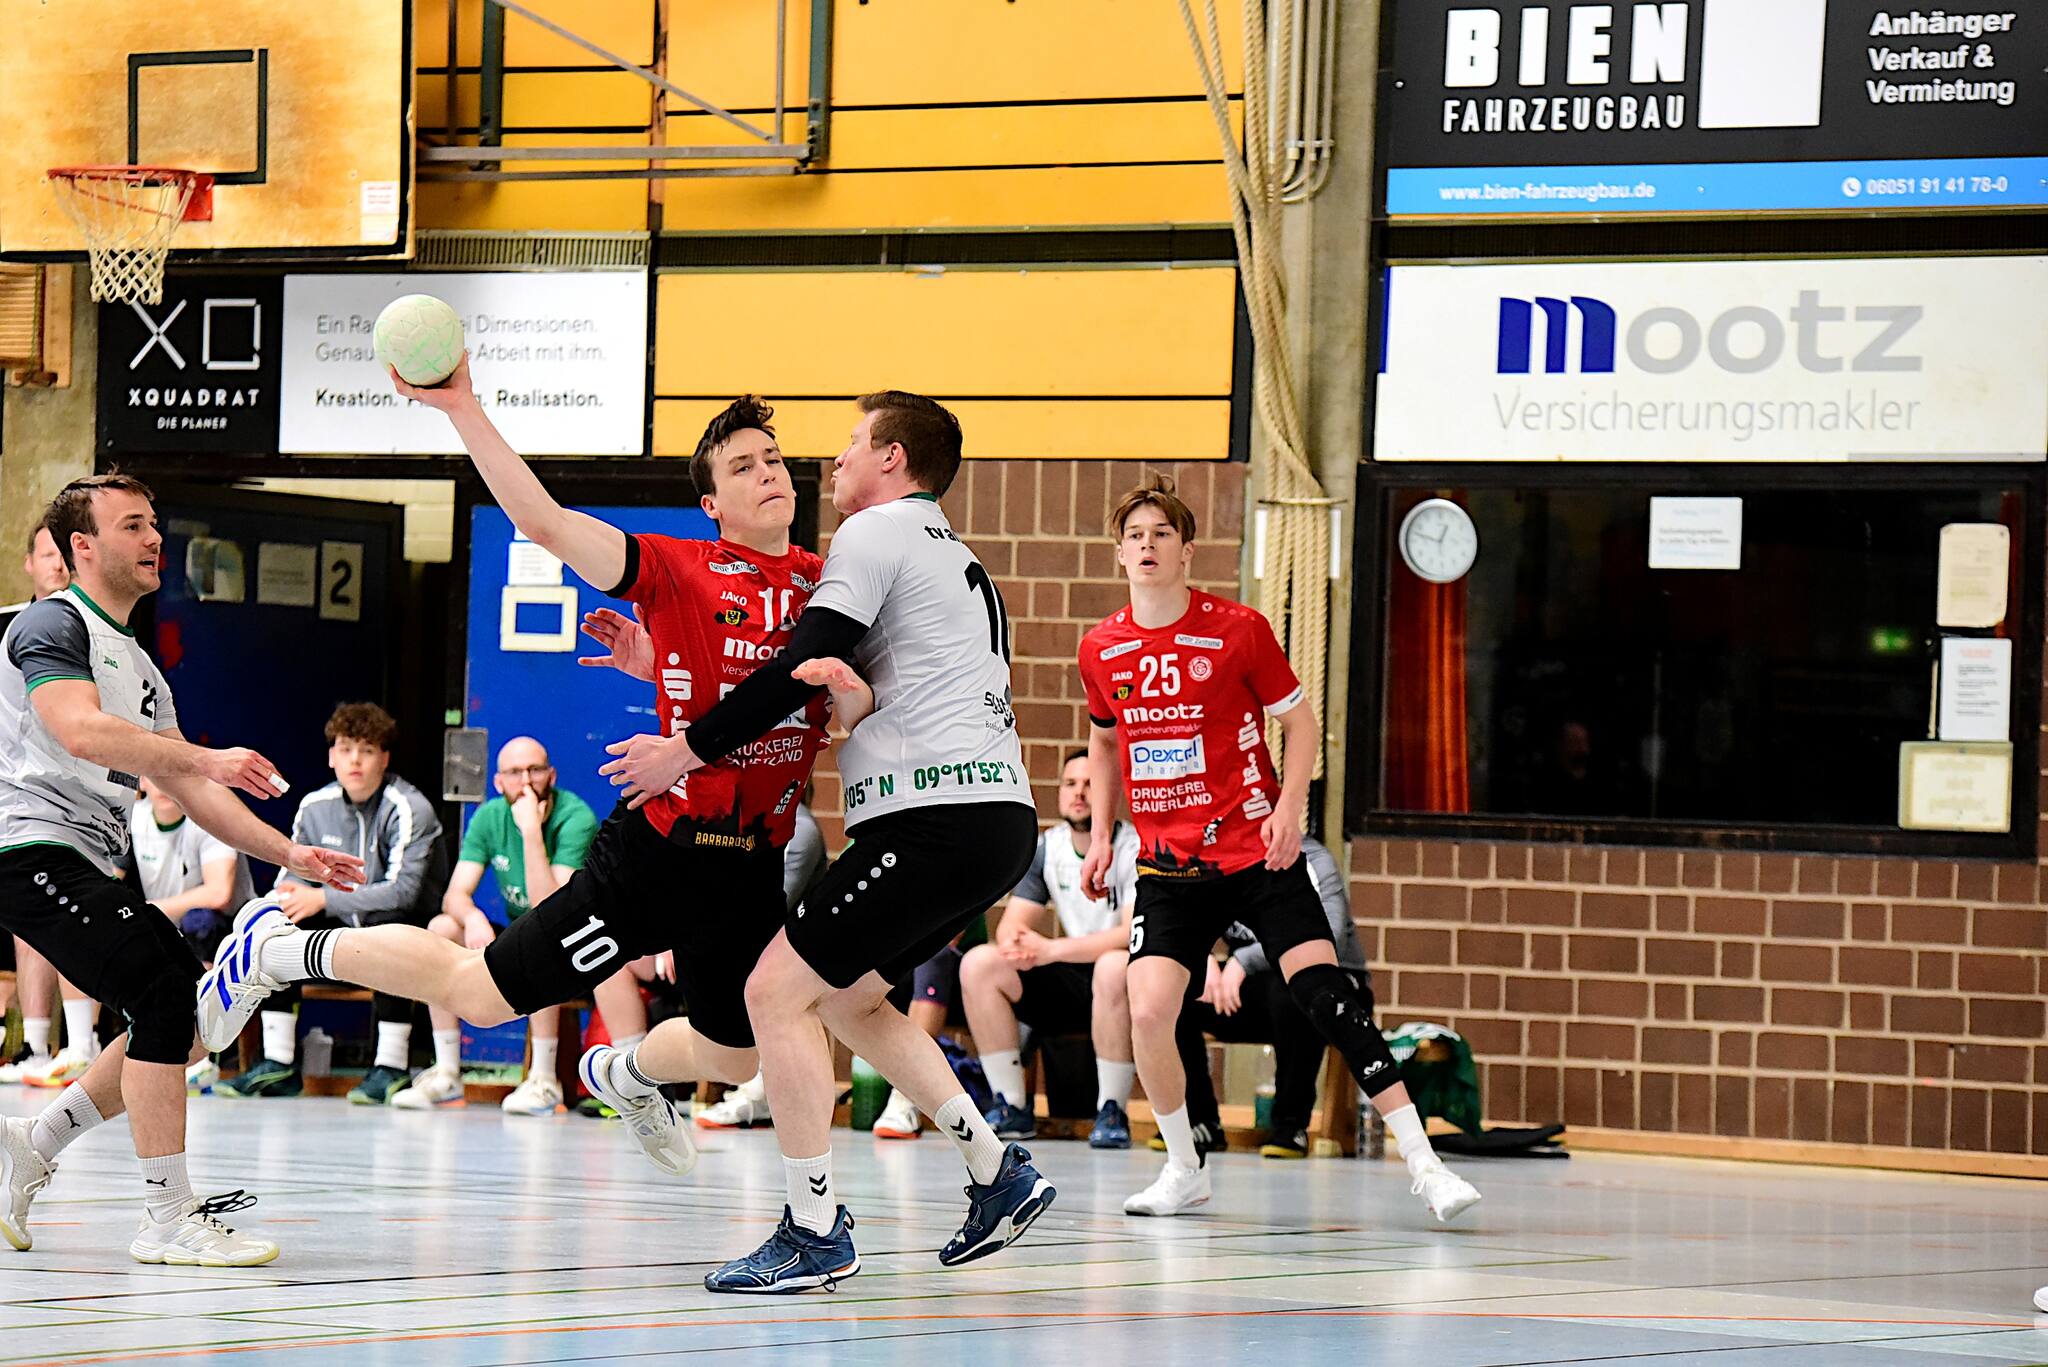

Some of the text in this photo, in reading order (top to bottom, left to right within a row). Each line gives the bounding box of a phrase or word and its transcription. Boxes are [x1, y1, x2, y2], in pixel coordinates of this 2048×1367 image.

[1869, 10, 2017, 39] Anhänger
[1444, 2, 1690, 87] BIEN
[1867, 43, 1996, 72] Verkauf &
[1865, 76, 2016, 106] Vermietung
[1442, 94, 1686, 133] FAHRZEUGBAU
[1438, 180, 1657, 204] www.bien-fahrzeugbau.de
[1866, 176, 2009, 195] 06051 91 41 78-0
[315, 314, 345, 334] Ein
[475, 313, 598, 336] Dimensionen.
[1497, 289, 1924, 376] mootz
[477, 342, 532, 362] Arbeit
[536, 342, 564, 361] mit
[570, 342, 607, 362] ihm.
[128, 388, 260, 407] XQUADRAT
[314, 388, 399, 408] Kreation.
[496, 387, 604, 408] Realisation.
[156, 416, 228, 430] DIE PLANER
[1492, 388, 1922, 441] Versicherungsmakler
[330, 559, 354, 606] 2
[720, 590, 748, 607] JAKO
[1111, 670, 1134, 682] JAKO
[1139, 653, 1181, 698] 25
[1123, 702, 1205, 725] mootz
[1131, 781, 1206, 801] DRUCKEREI
[1132, 792, 1213, 814] SAUERLAND
[117, 906, 134, 919] 22
[560, 914, 620, 972] 10
